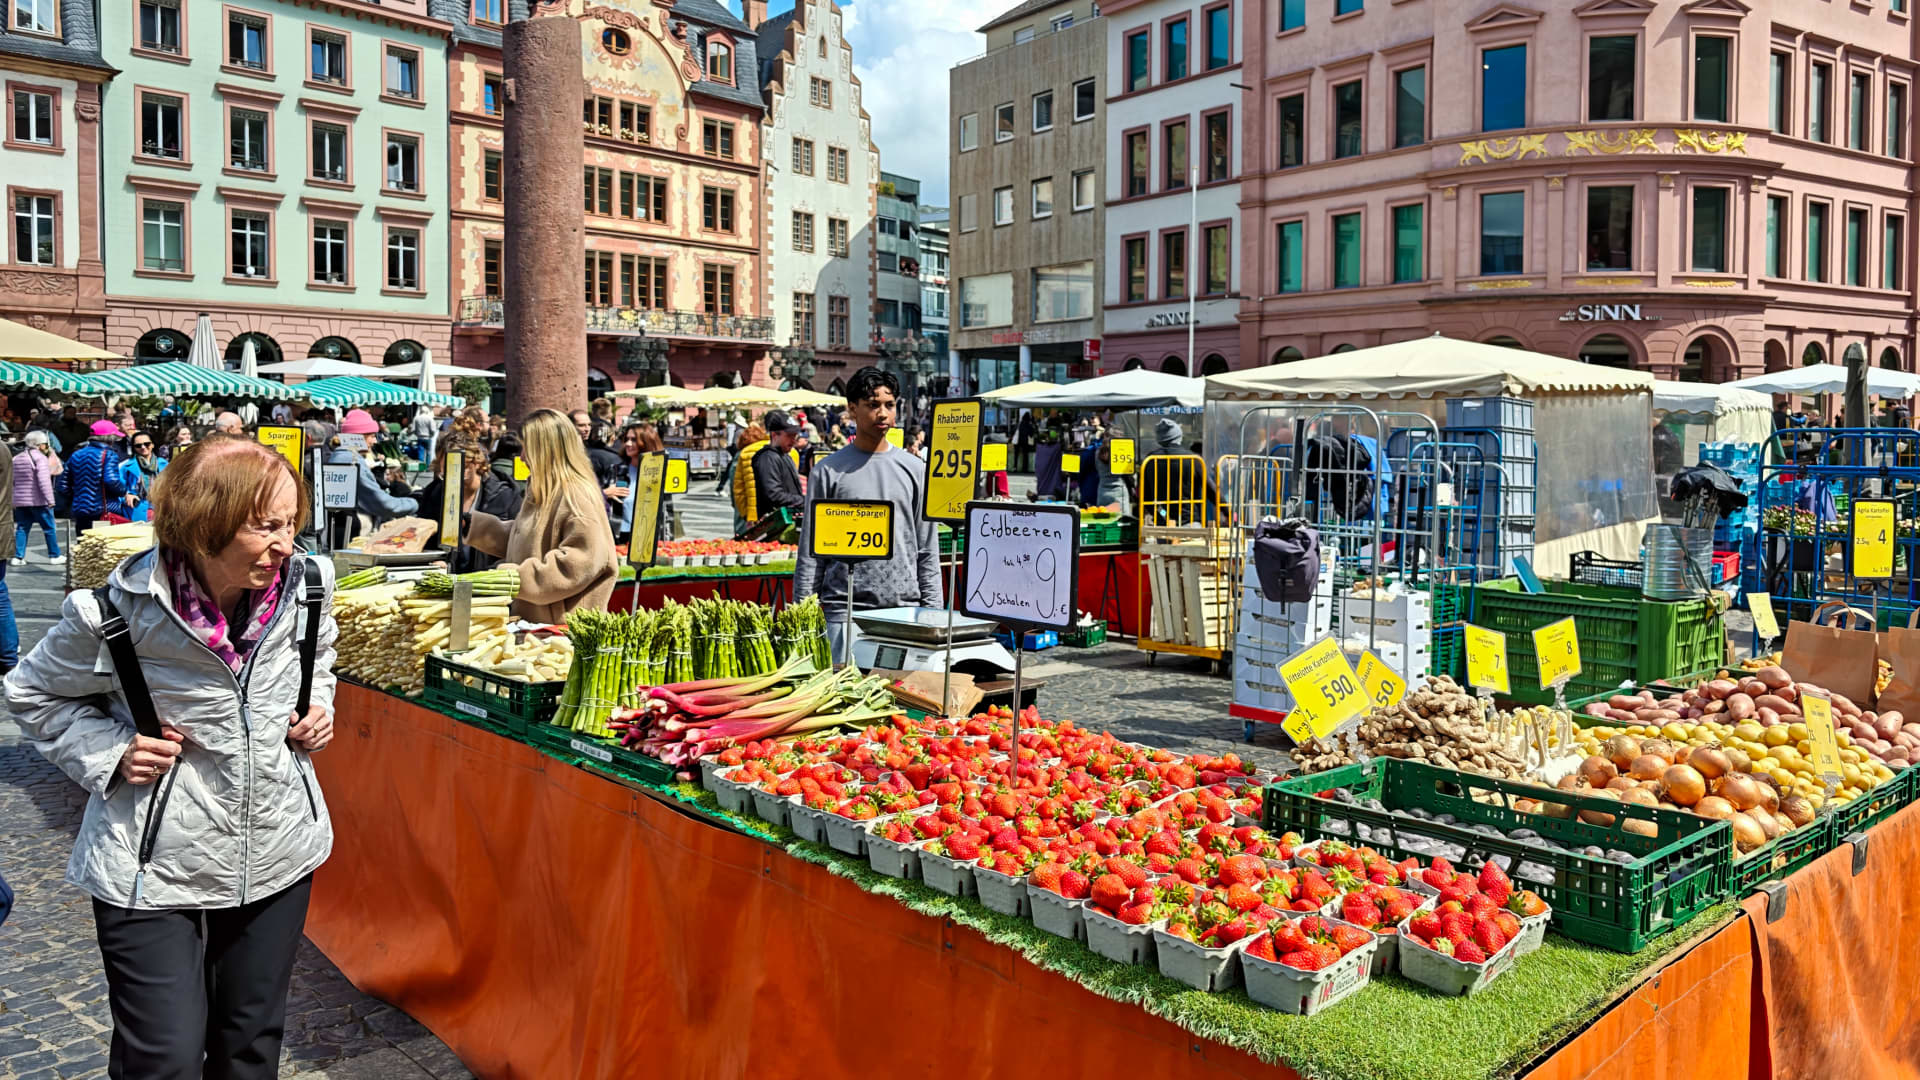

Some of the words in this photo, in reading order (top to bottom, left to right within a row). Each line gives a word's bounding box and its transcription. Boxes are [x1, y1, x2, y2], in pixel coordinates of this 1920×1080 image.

[1577, 303, 1642, 321] SiNN
[937, 413, 975, 424] Rhabarber
[267, 432, 297, 440] Spargel
[932, 449, 972, 479] 2,95
[323, 471, 347, 482] älzer
[672, 476, 680, 488] 9
[326, 491, 348, 505] argel
[826, 508, 854, 517] Grüner
[856, 509, 886, 518] Spargel
[980, 513, 1061, 540] Erdbeeren
[1878, 528, 1887, 545] 4
[968, 547, 995, 608] 2
[997, 592, 1030, 607] Schalen
[1566, 640, 1573, 655] 8
[1494, 653, 1500, 670] 7
[1291, 718, 1309, 735] Ing
